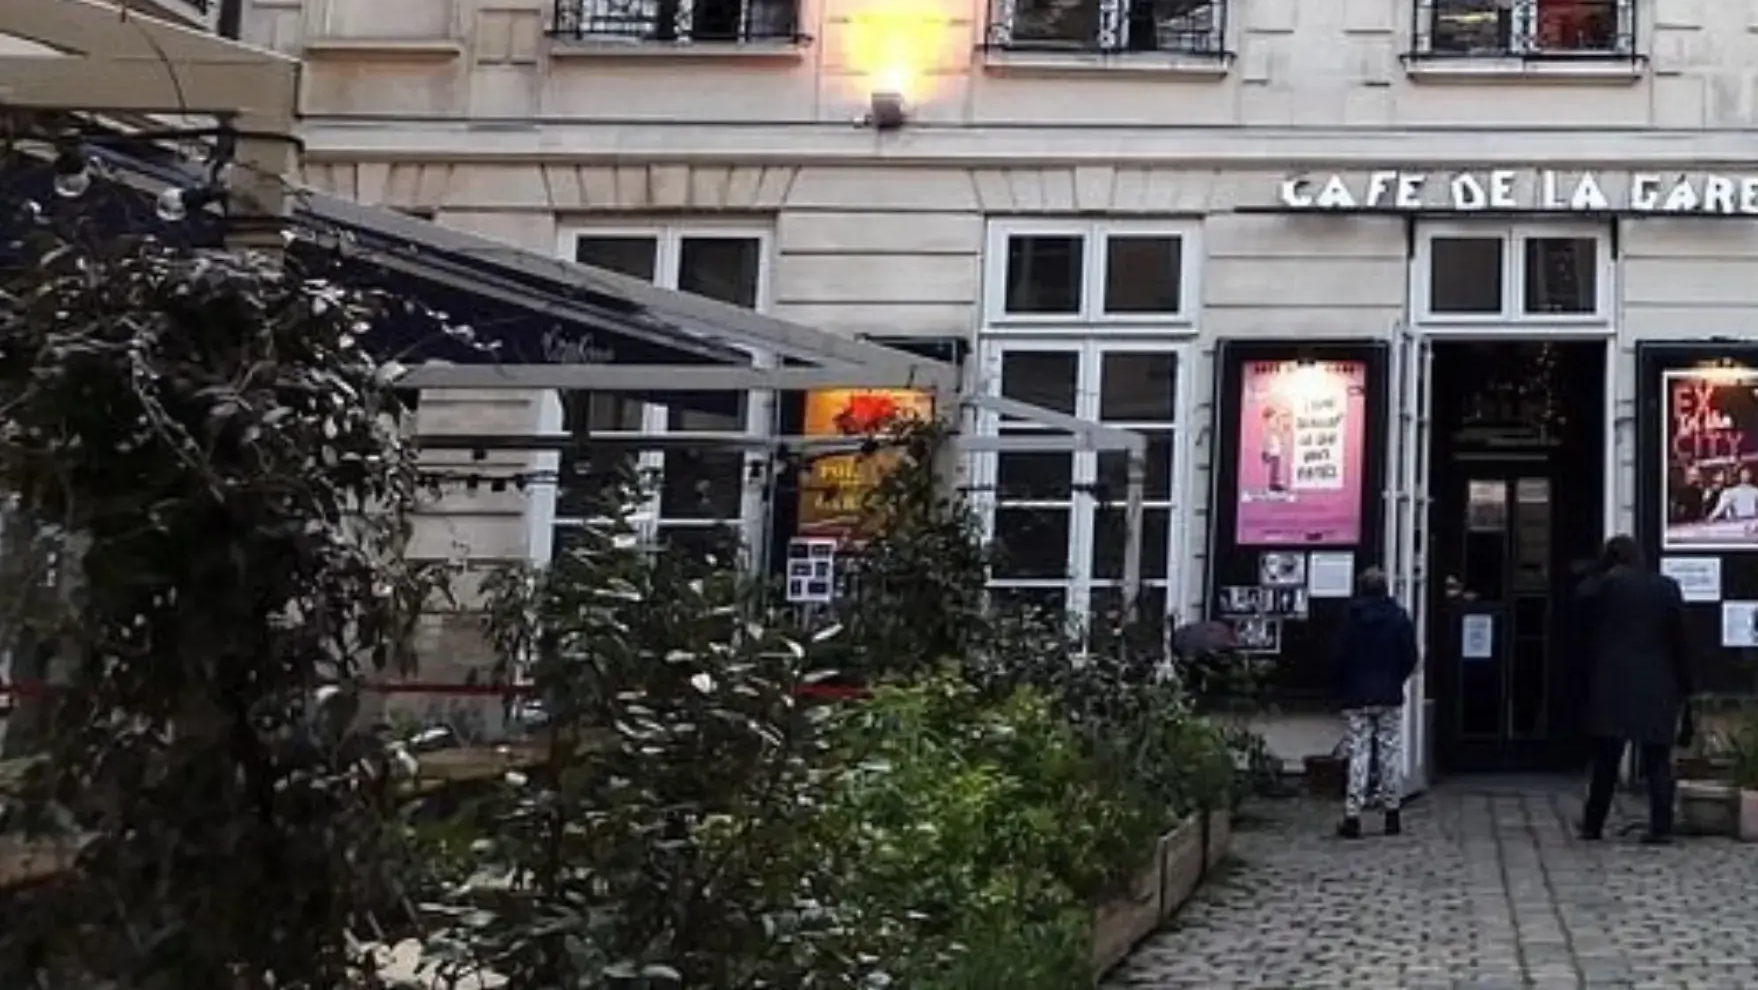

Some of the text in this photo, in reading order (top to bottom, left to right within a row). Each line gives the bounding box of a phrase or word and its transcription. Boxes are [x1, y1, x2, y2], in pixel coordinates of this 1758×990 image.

[1281, 170, 1425, 207] CAFE
[1452, 170, 1517, 209] DE
[1543, 170, 1608, 208] LA
